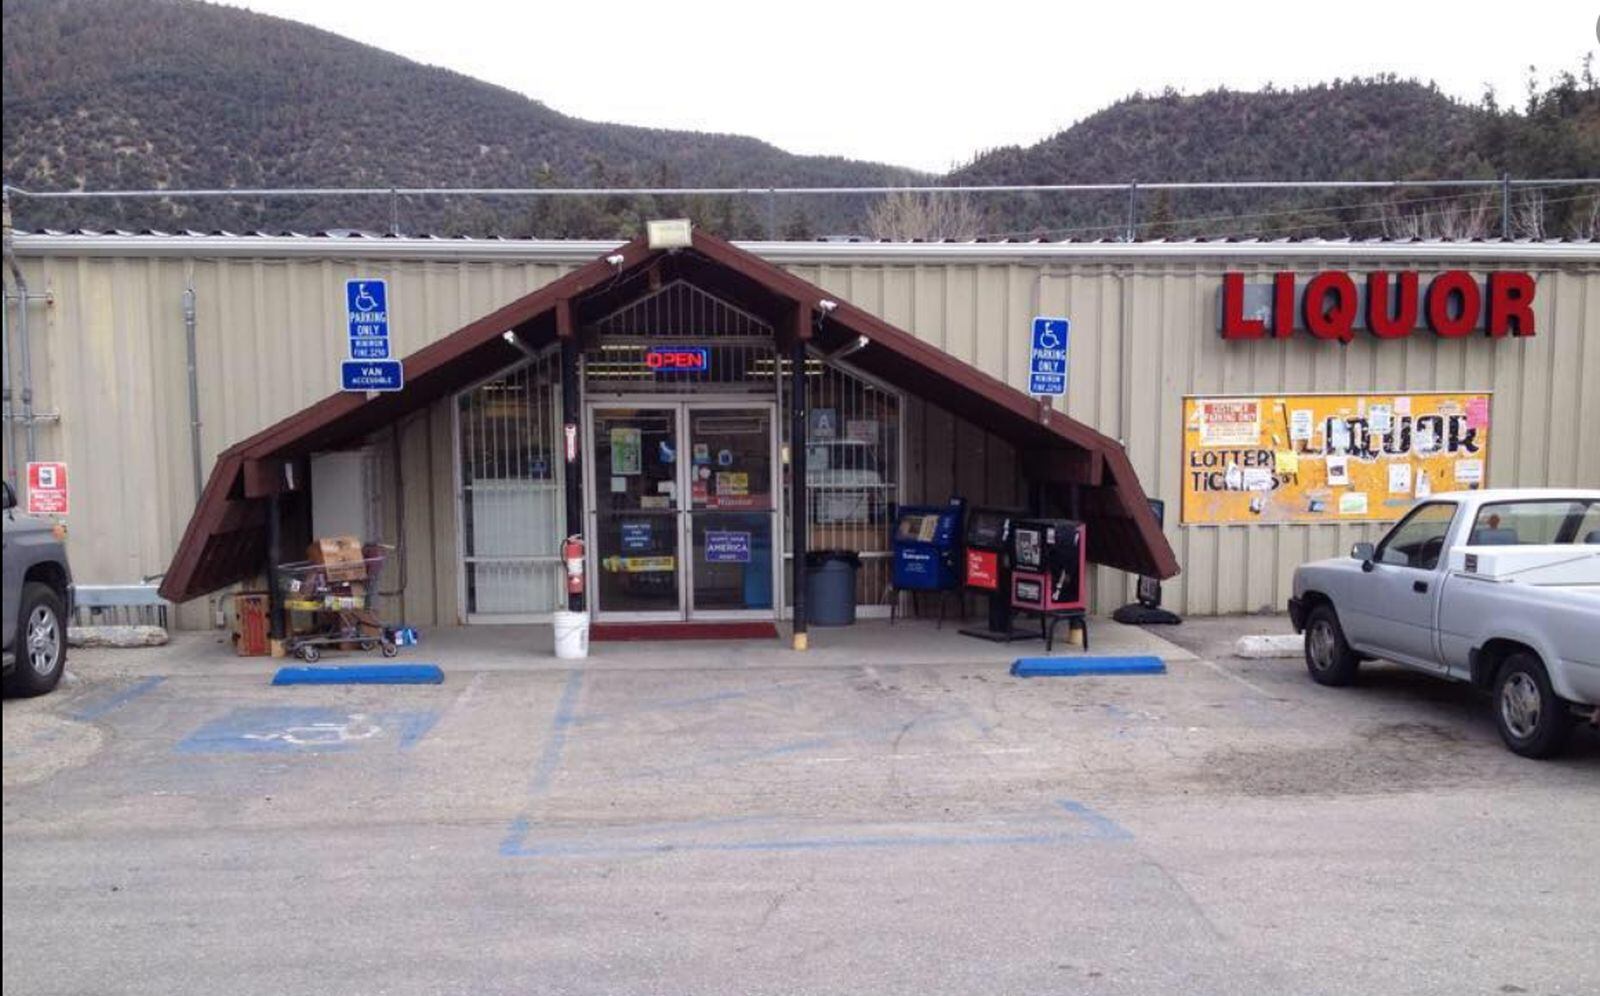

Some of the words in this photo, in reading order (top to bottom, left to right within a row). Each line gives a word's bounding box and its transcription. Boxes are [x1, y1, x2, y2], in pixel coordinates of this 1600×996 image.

[1222, 270, 1536, 345] LIQUOR
[350, 312, 386, 323] PARKING
[357, 325, 379, 335] ONLY
[1033, 349, 1066, 360] PARKING
[646, 352, 703, 368] OPEN
[1038, 361, 1059, 371] ONLY
[361, 367, 382, 376] VAN
[708, 544, 748, 552] AMERICA
